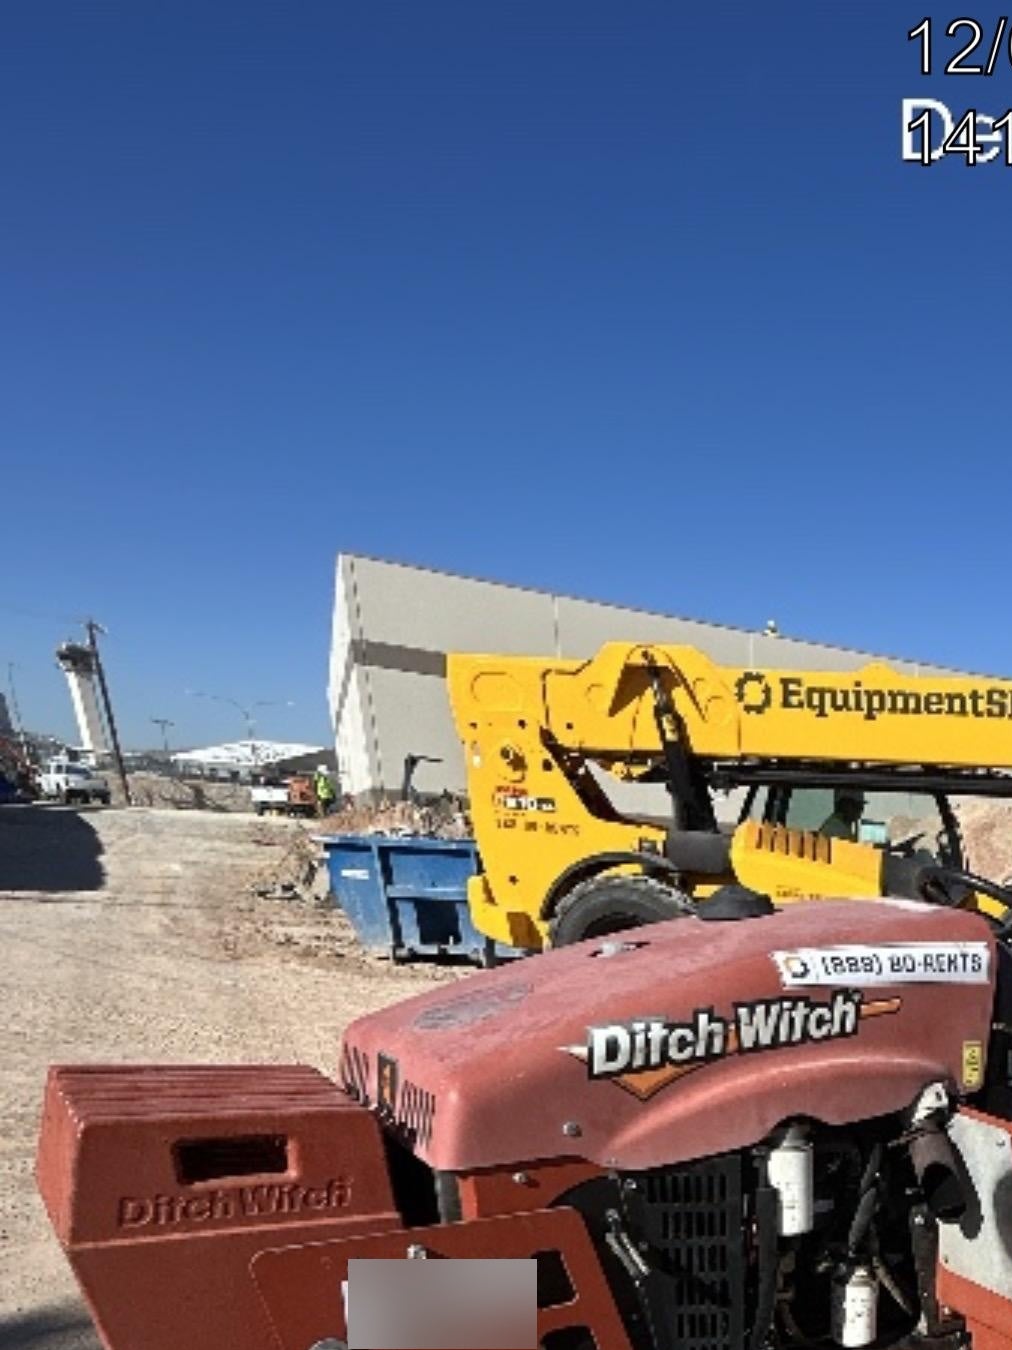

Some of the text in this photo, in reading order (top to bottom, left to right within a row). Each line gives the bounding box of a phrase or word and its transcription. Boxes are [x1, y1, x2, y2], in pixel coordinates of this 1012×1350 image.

[590, 991, 860, 1077] Ditch Witch
[117, 1177, 352, 1228] Ditch Witch
